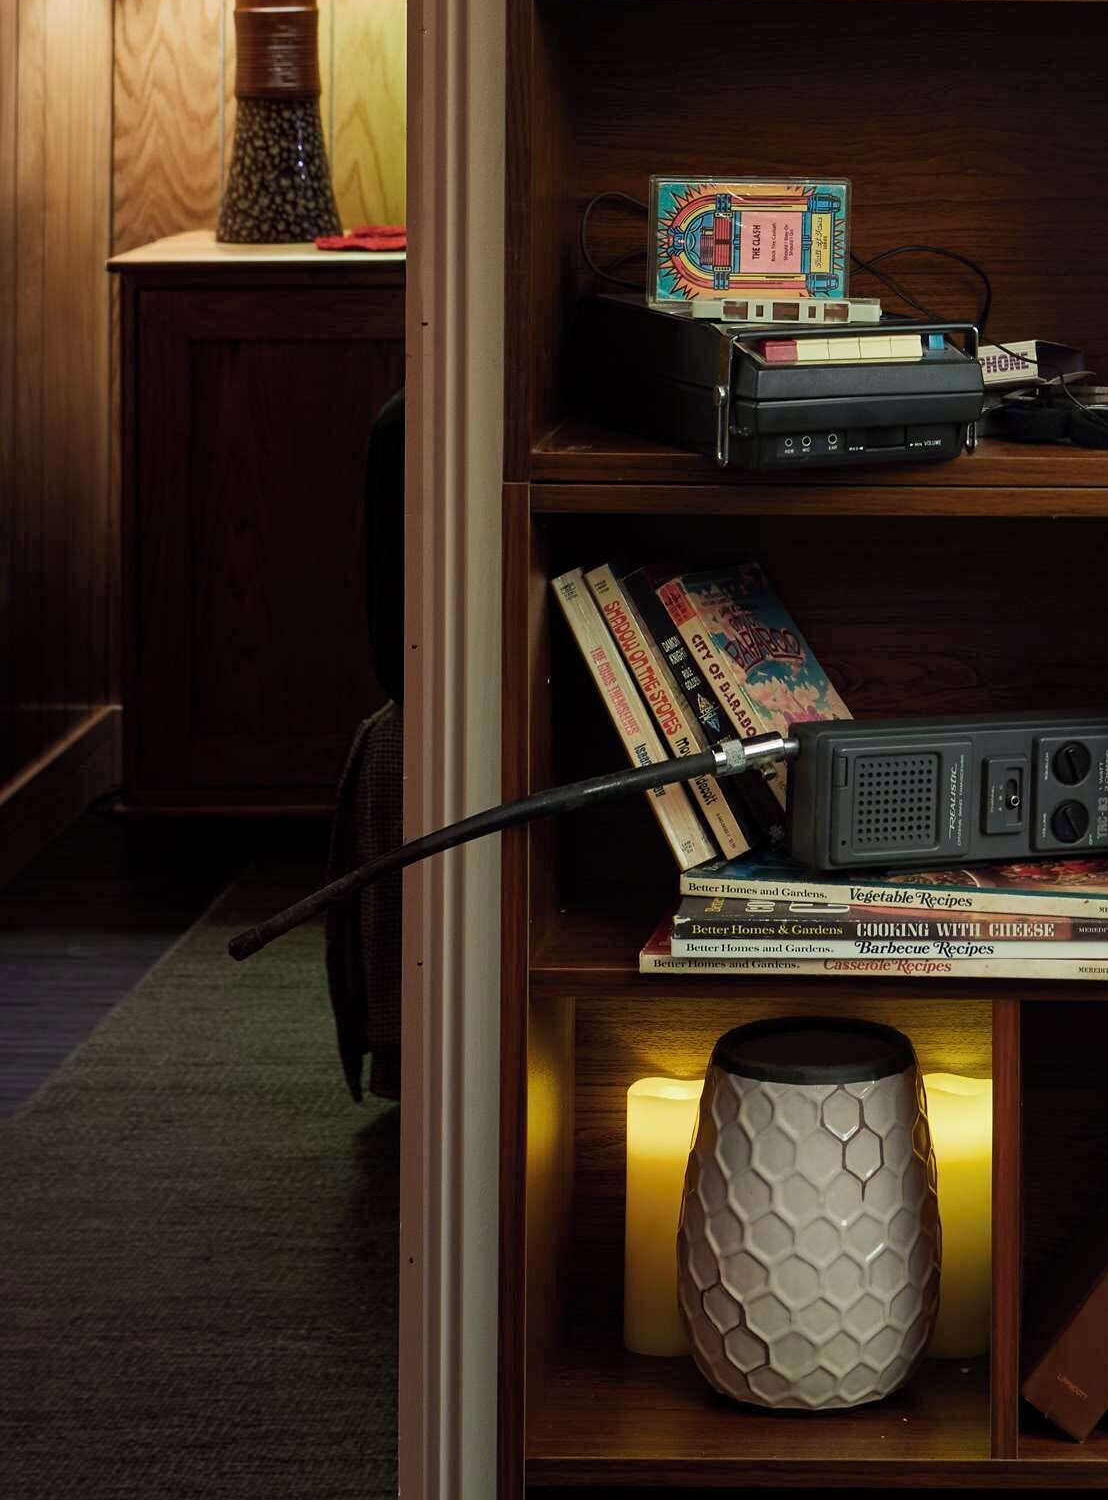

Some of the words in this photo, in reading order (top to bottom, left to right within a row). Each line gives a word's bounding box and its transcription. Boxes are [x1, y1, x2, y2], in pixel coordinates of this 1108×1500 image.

[752, 224, 760, 245] CLASH
[752, 245, 760, 260] THE
[692, 633, 714, 661] CITY
[708, 663, 726, 681] OF
[688, 882, 721, 894] Better
[721, 884, 758, 896] Homes
[760, 886, 780, 897] and
[781, 888, 828, 899] Gardens.
[850, 888, 914, 904] Vegetable
[915, 891, 973, 908] Recipes
[691, 924, 730, 935] Better
[729, 924, 776, 935] Homes
[778, 924, 789, 935] &
[791, 924, 843, 935] Gardens
[856, 923, 929, 937] COOKING
[936, 923, 982, 937] WITH
[988, 923, 1055, 937] CHEESE
[686, 943, 719, 953] Better
[720, 943, 760, 953] Homes
[762, 943, 783, 953] and
[785, 943, 835, 953] Gardens.
[854, 941, 930, 954] Barbecue
[933, 941, 995, 958] Recipes
[653, 958, 688, 969] Better
[688, 959, 727, 969] Homes
[729, 959, 749, 969] and
[751, 959, 800, 969] Gardens.
[823, 958, 891, 972] Casserole
[891, 958, 952, 975] Recipes
